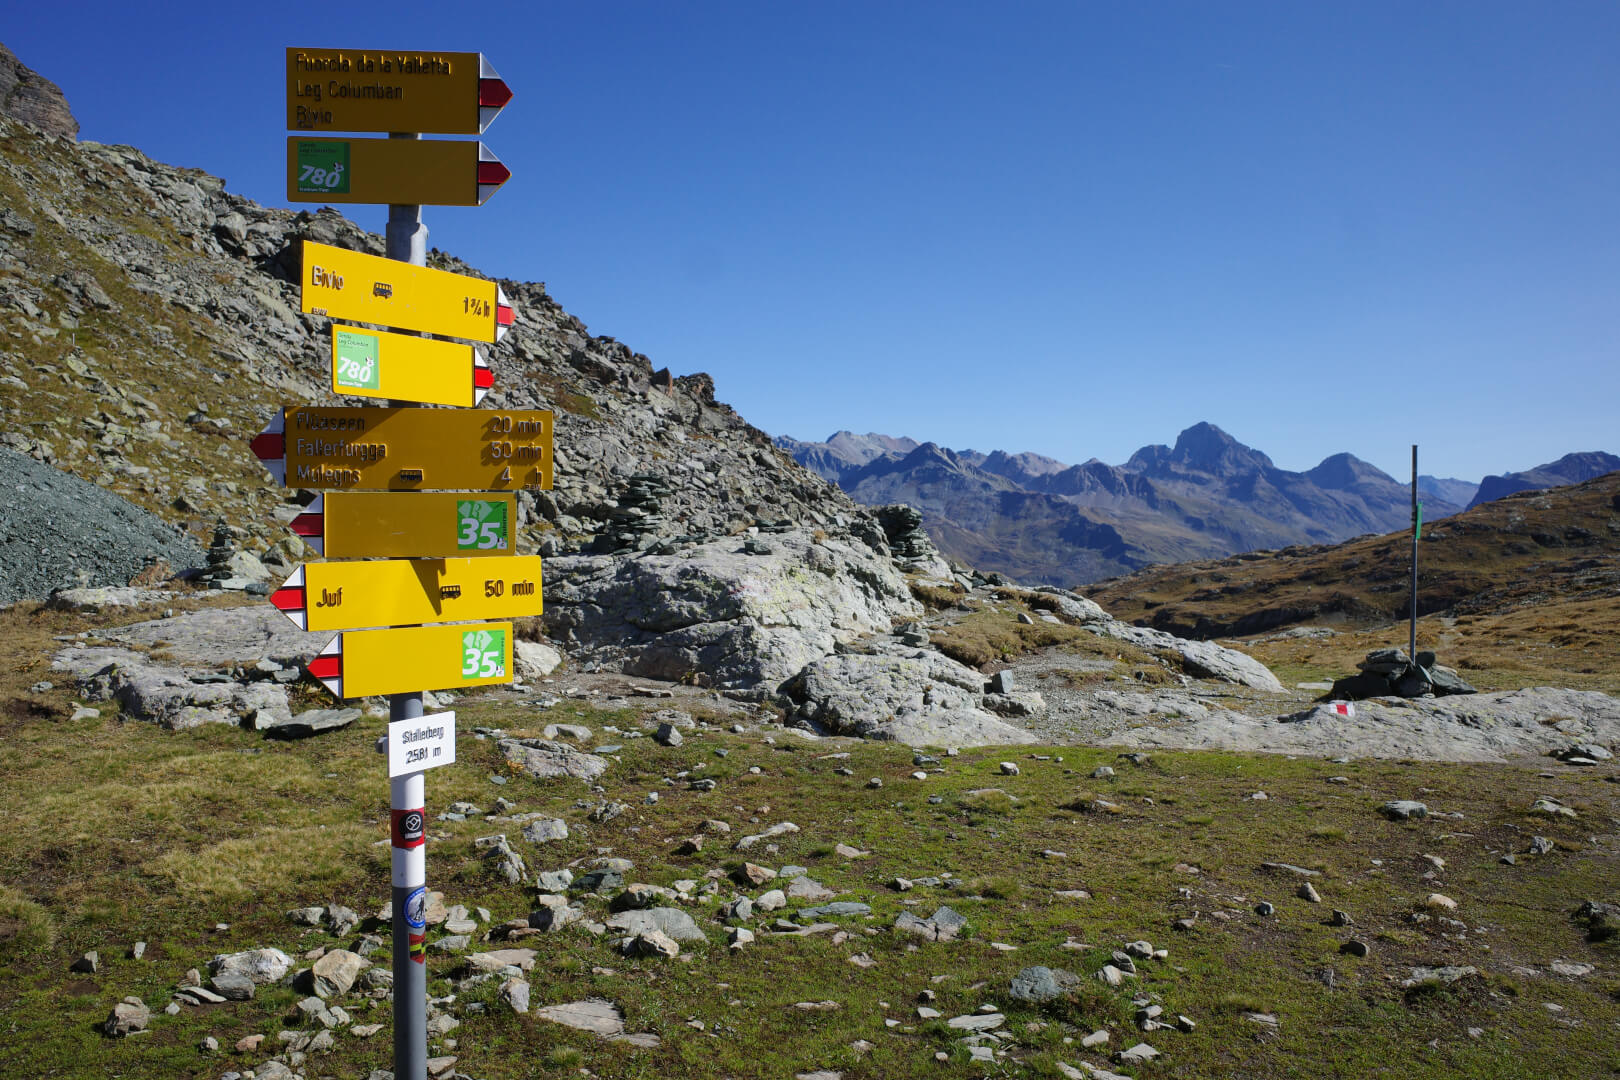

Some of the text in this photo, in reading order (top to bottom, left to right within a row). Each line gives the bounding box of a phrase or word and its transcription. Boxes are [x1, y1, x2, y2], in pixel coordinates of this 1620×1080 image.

[296, 53, 451, 75] Fuorcla da la Valletta
[296, 80, 403, 101] Leg Columban
[296, 105, 332, 124] Bivio
[298, 165, 340, 188] 780
[311, 265, 345, 291] Bivio
[337, 356, 371, 383] 780
[491, 415, 512, 433] 20
[518, 417, 543, 433] min
[296, 439, 543, 461] Fallerfurgga 50 min
[296, 464, 361, 486] Mulegns
[501, 467, 512, 482] 4
[458, 519, 500, 550] 35
[316, 580, 535, 608] Juf 50 min
[462, 648, 500, 677] 35
[402, 727, 444, 744] Stallerberg
[406, 746, 442, 764] 2581 m
